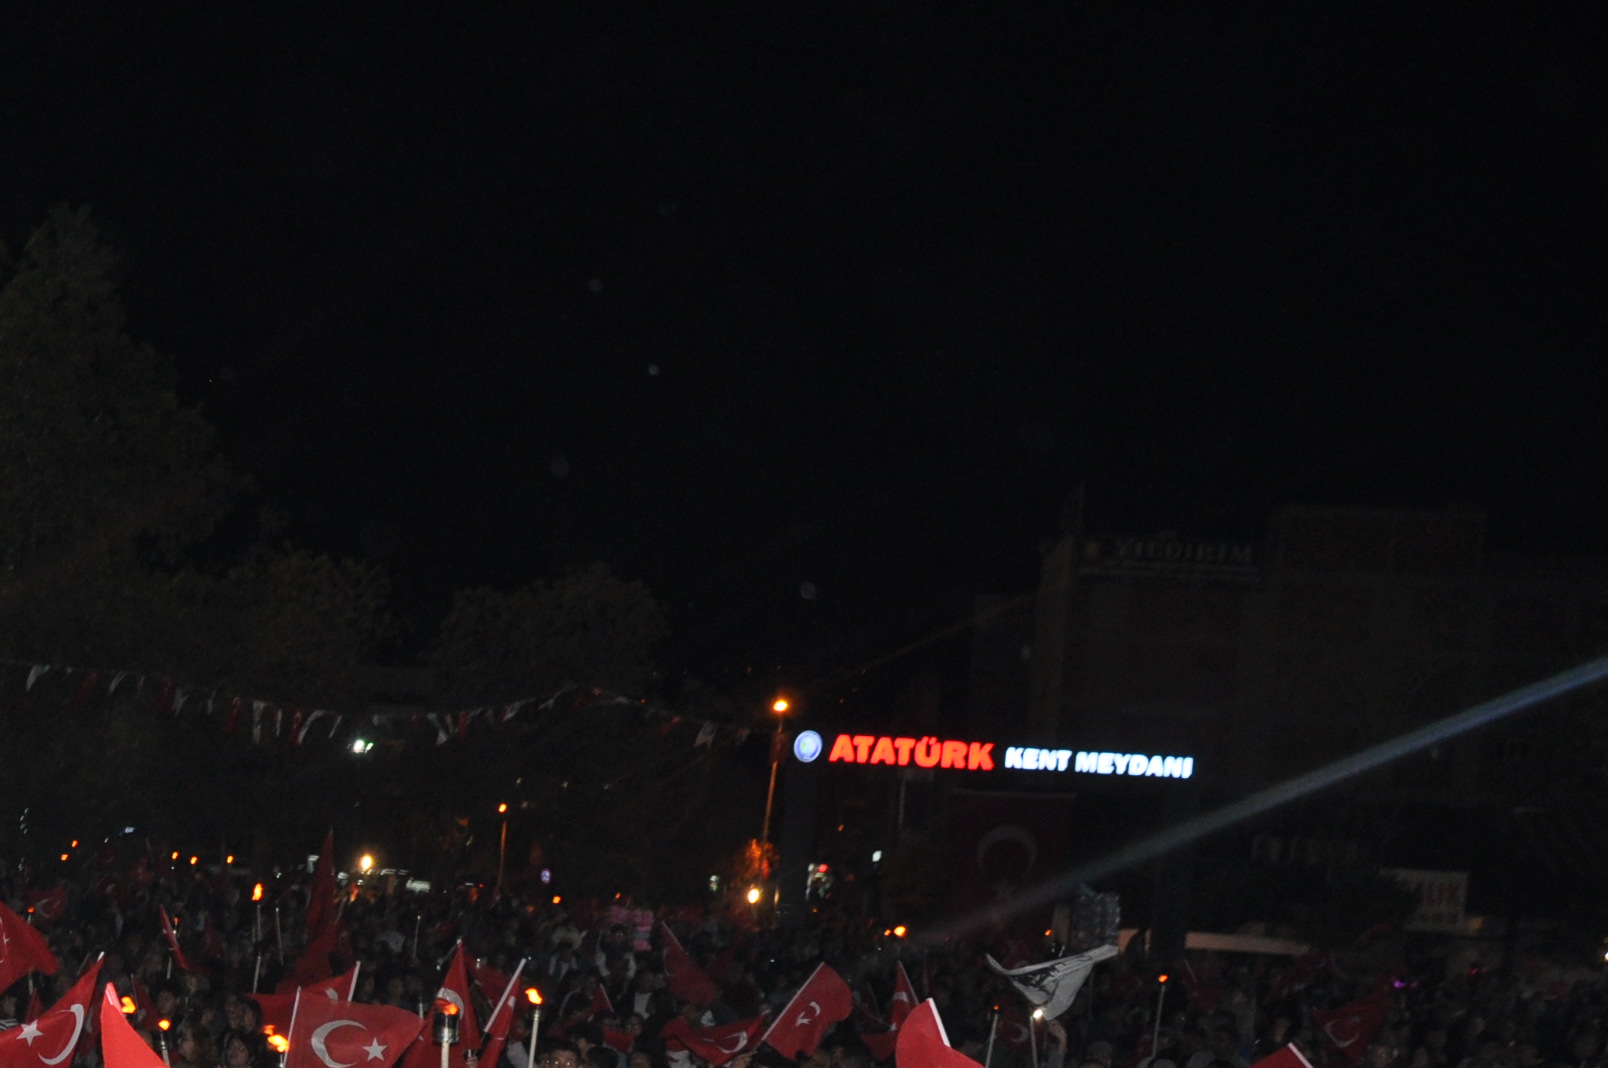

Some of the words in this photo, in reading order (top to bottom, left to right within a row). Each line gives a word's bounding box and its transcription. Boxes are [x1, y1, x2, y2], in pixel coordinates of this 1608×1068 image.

[828, 734, 994, 770] ATATÜRK
[1005, 747, 1072, 771] KENT
[1075, 751, 1194, 778] MEYDANI
